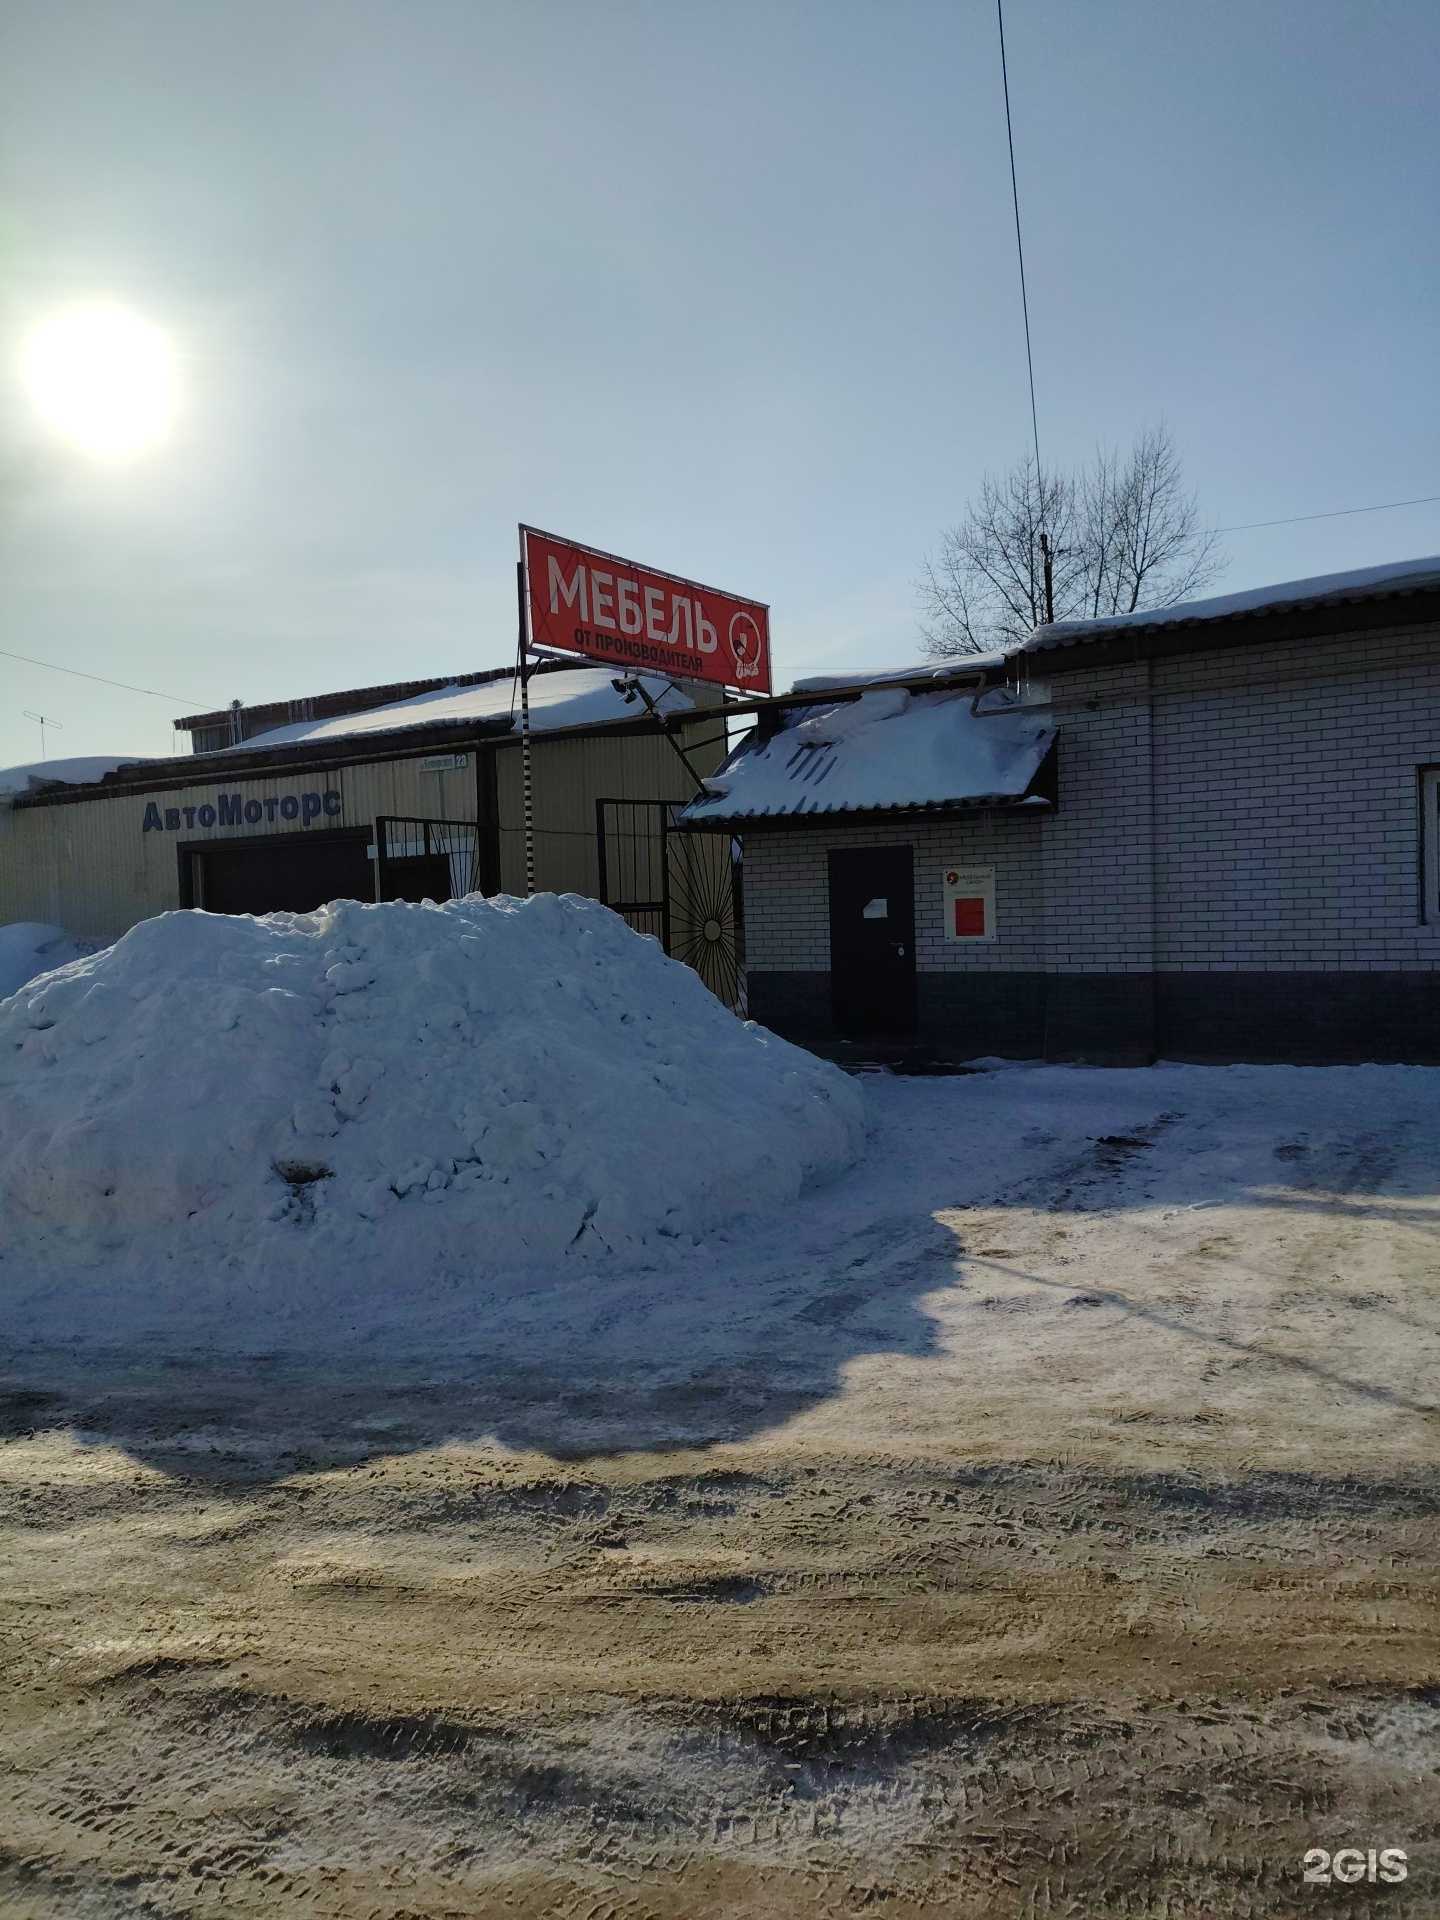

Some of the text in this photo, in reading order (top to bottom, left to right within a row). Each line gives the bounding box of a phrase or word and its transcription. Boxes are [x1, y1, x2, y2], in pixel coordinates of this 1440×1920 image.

[547, 555, 718, 654] МЕБЕЛЬ
[574, 628, 592, 646] ОТ
[596, 633, 703, 673] ПРОИЗВОДИТЕЛЯ
